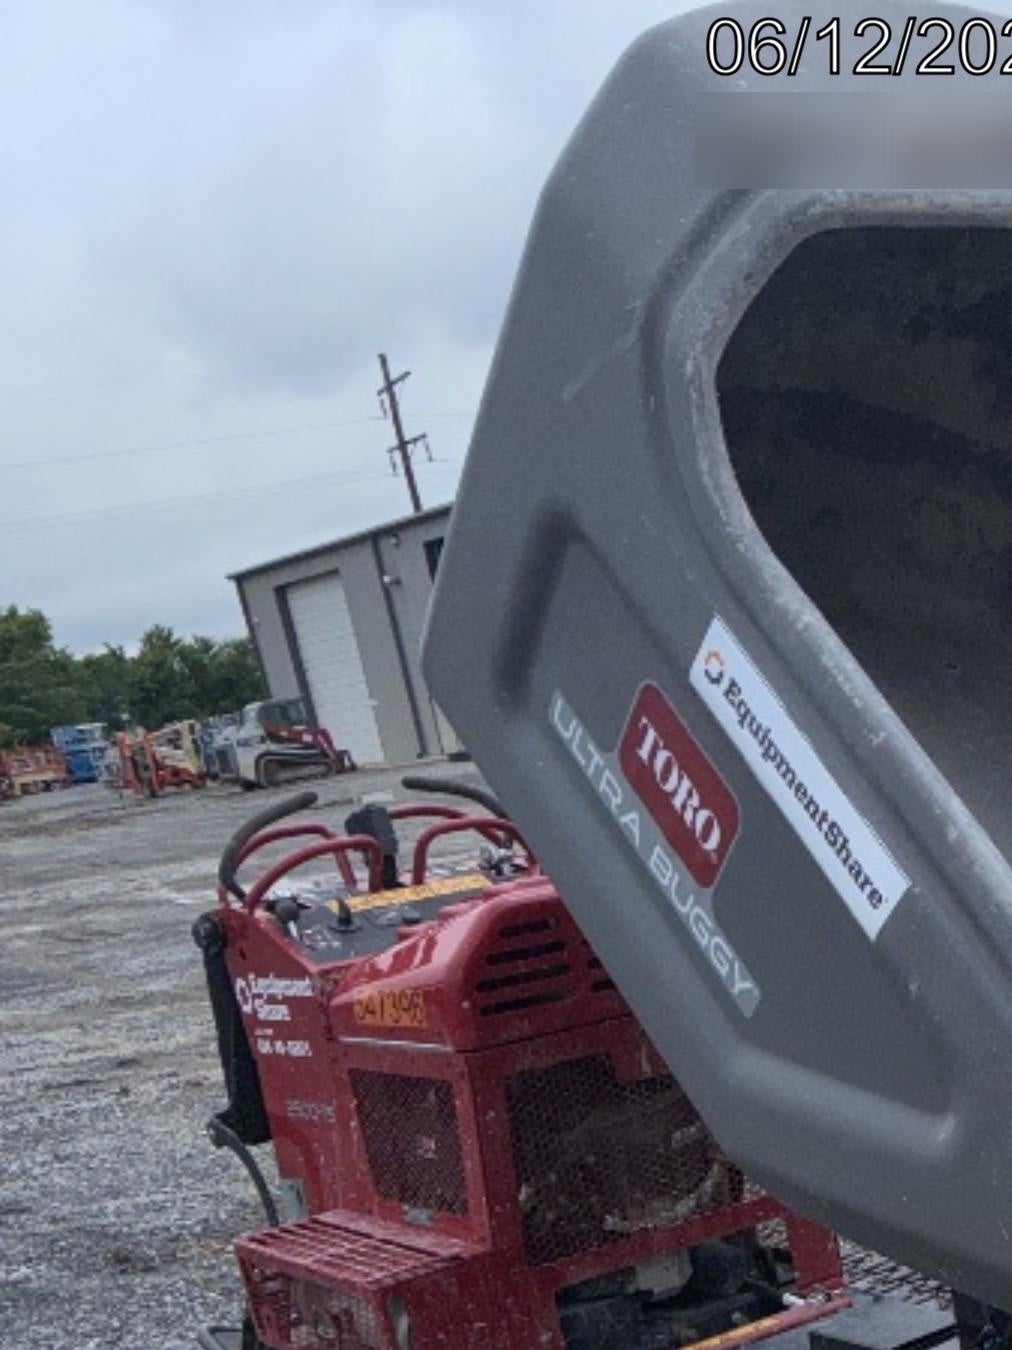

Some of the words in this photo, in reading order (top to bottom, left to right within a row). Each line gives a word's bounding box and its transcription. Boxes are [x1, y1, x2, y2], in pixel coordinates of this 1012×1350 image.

[554, 698, 641, 848] ULTRA
[649, 844, 753, 995] BUGGY
[636, 715, 721, 851] TORO
[722, 677, 884, 910] EquipmentShare
